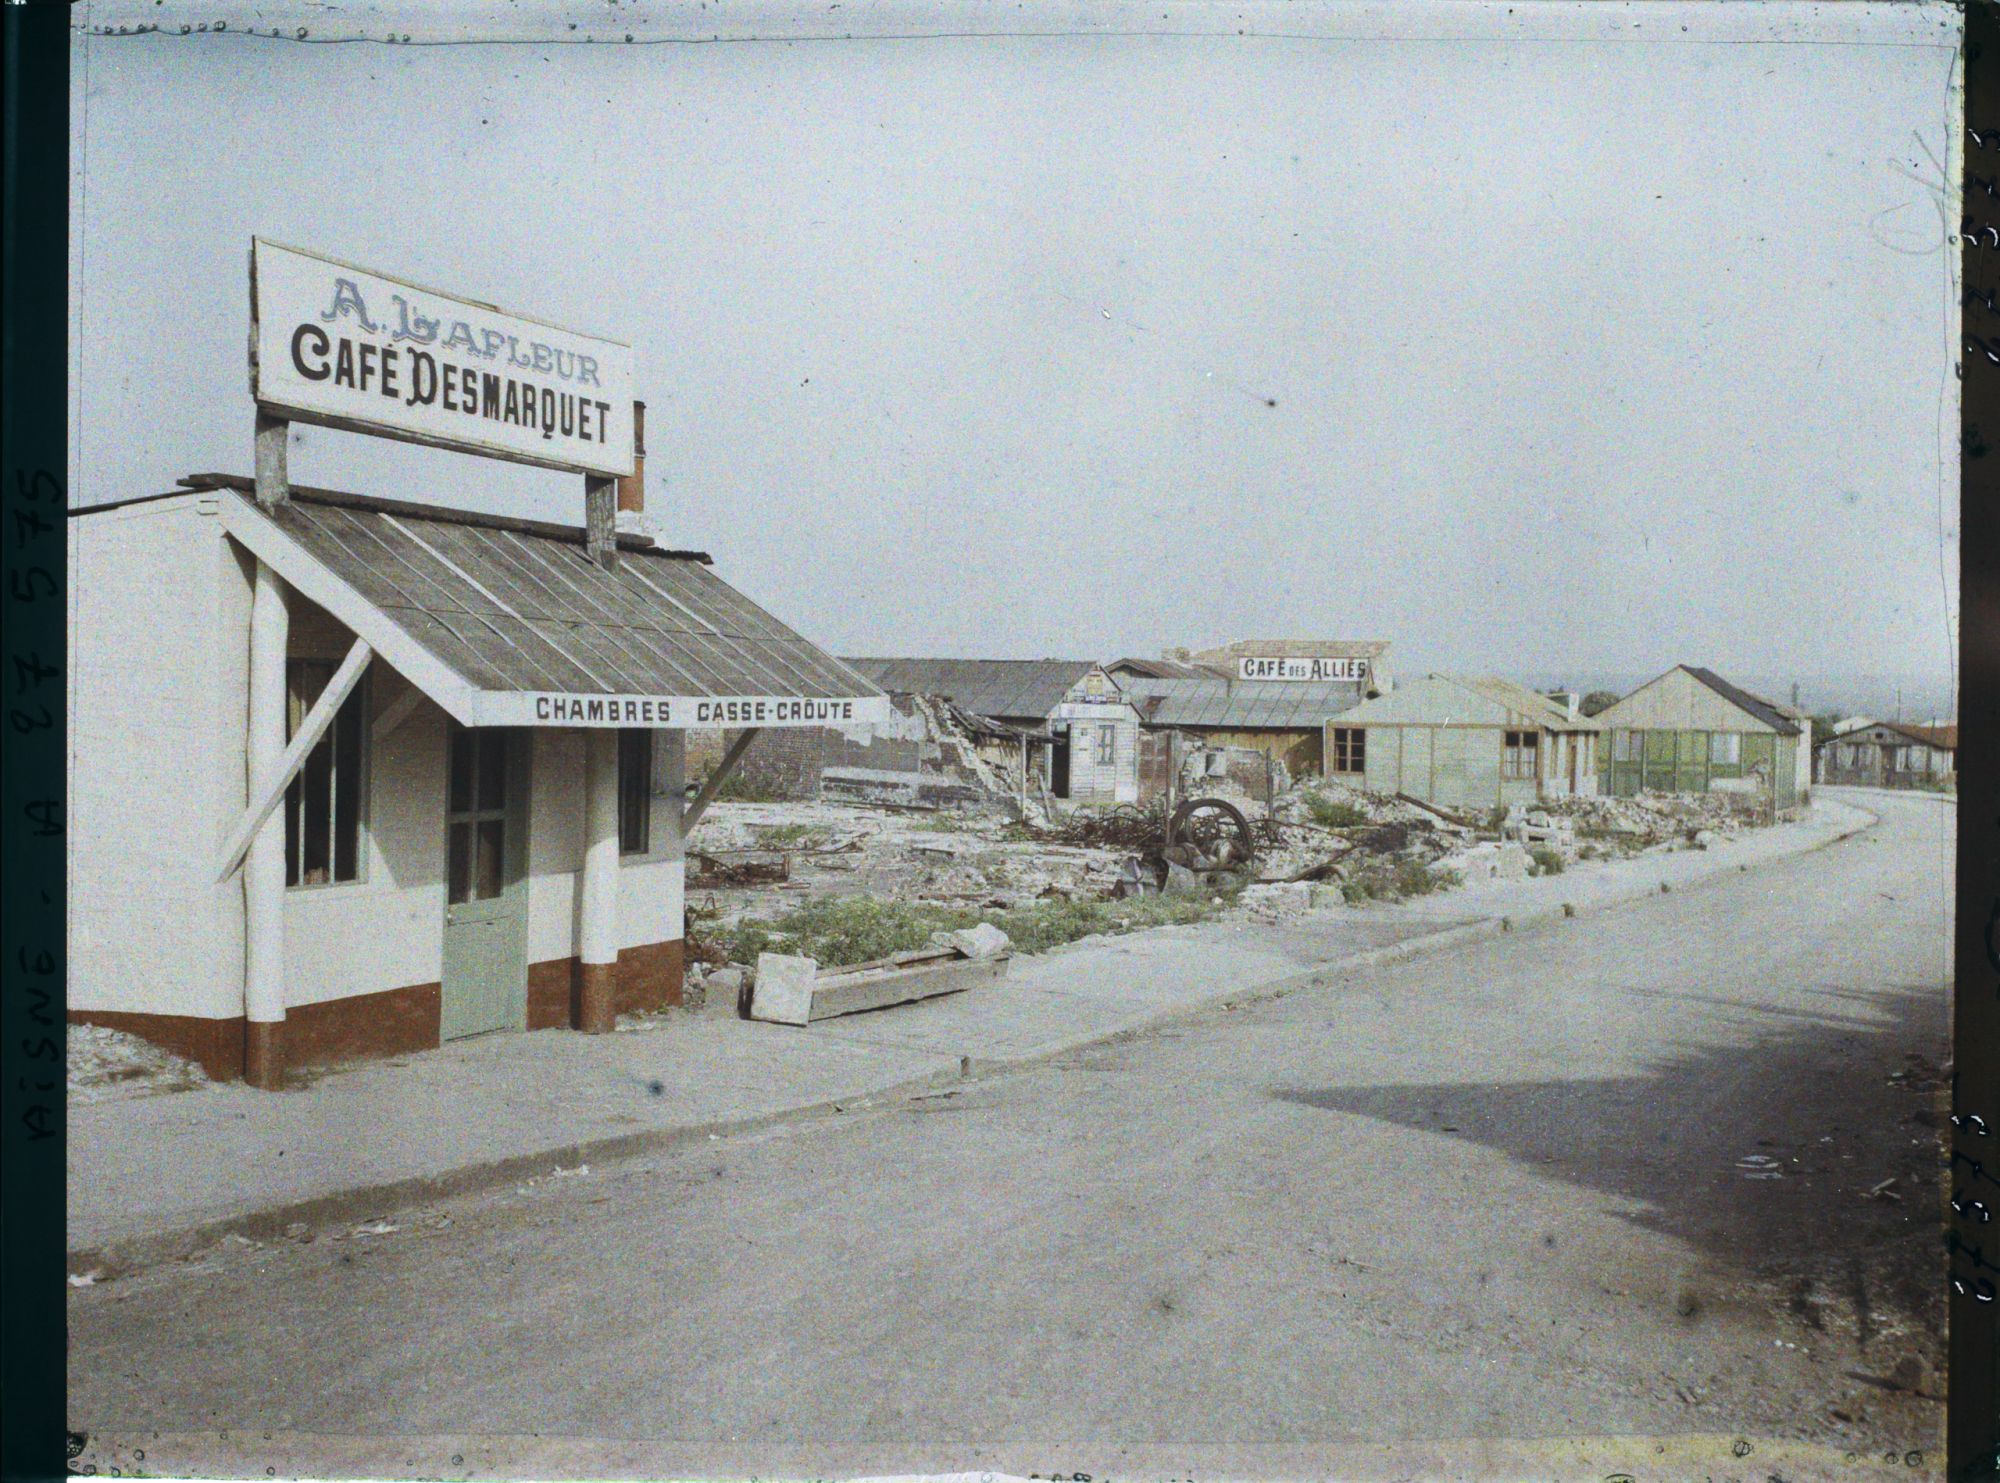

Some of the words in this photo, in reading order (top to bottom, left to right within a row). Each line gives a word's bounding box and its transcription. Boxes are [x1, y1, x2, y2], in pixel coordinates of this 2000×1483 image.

[291, 324, 400, 398] CAFÉ
[406, 346, 611, 443] DESMARQUET
[391, 294, 600, 386] LAFLEUR
[536, 697, 670, 722] CHAMBRES
